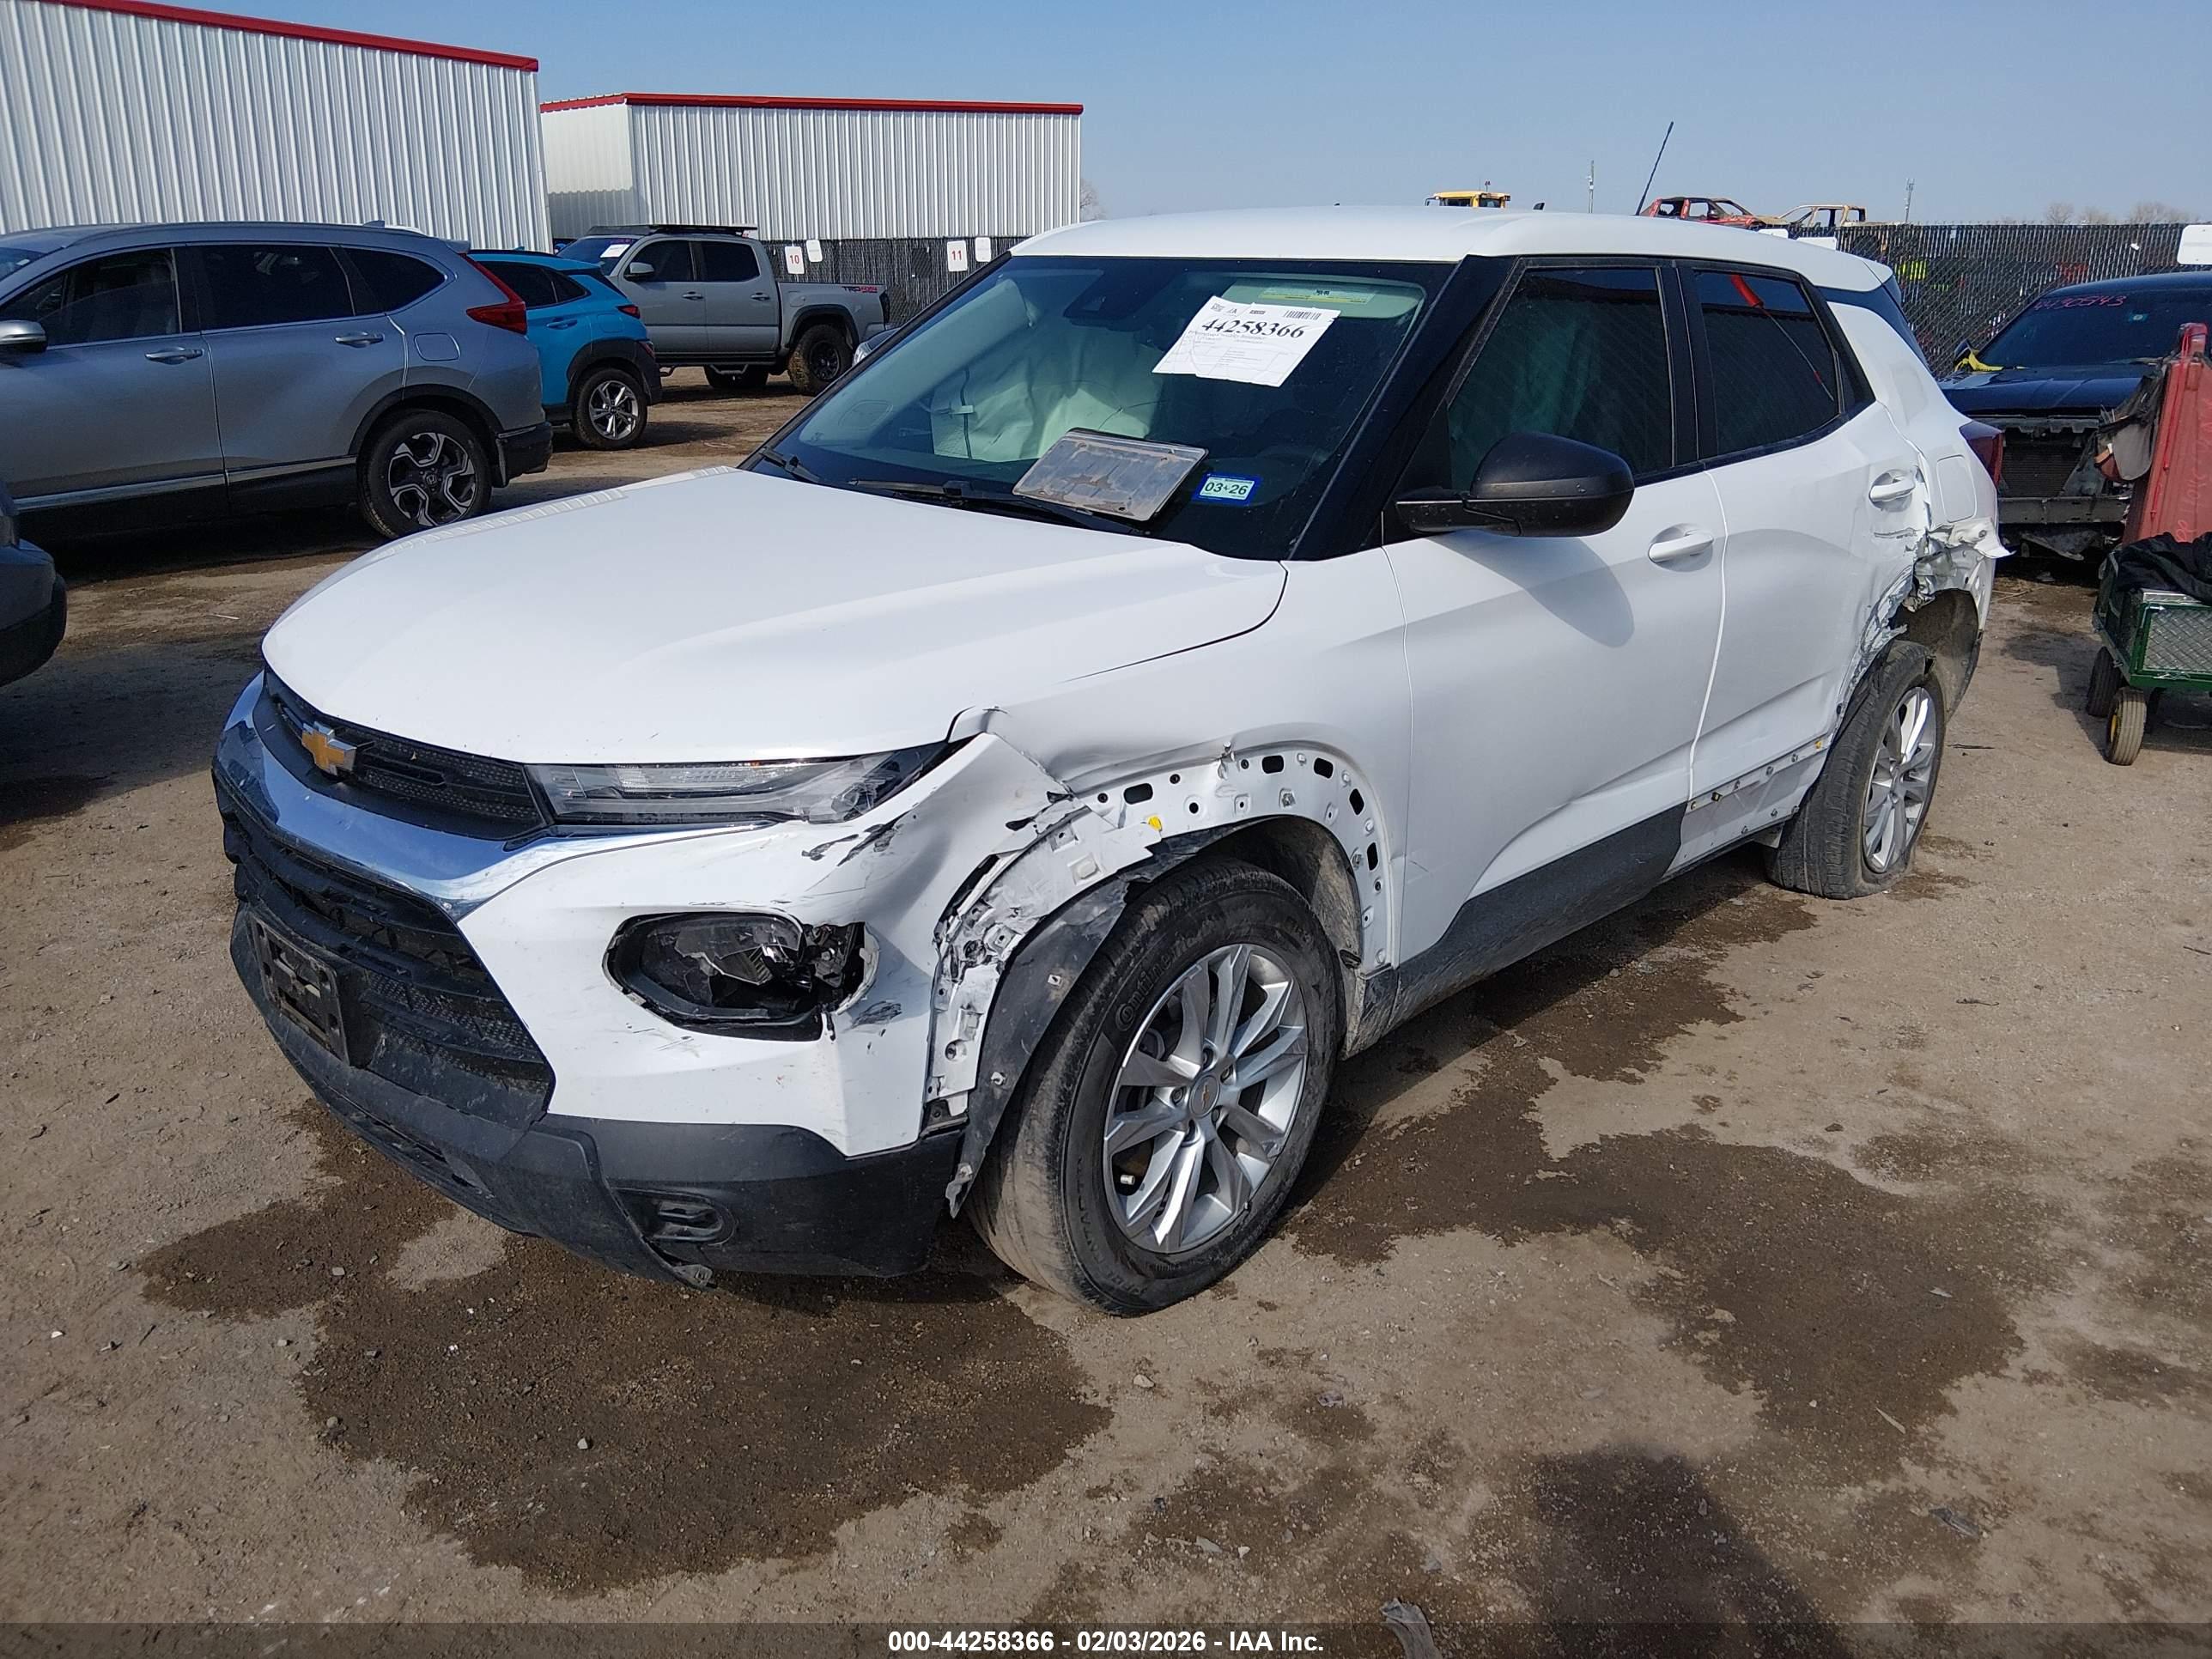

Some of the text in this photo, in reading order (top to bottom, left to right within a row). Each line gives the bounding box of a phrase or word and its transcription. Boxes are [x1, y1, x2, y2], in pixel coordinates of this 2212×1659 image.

[789, 254, 800, 264] 10
[951, 250, 963, 261] 11
[1201, 319, 1307, 338] 44258366
